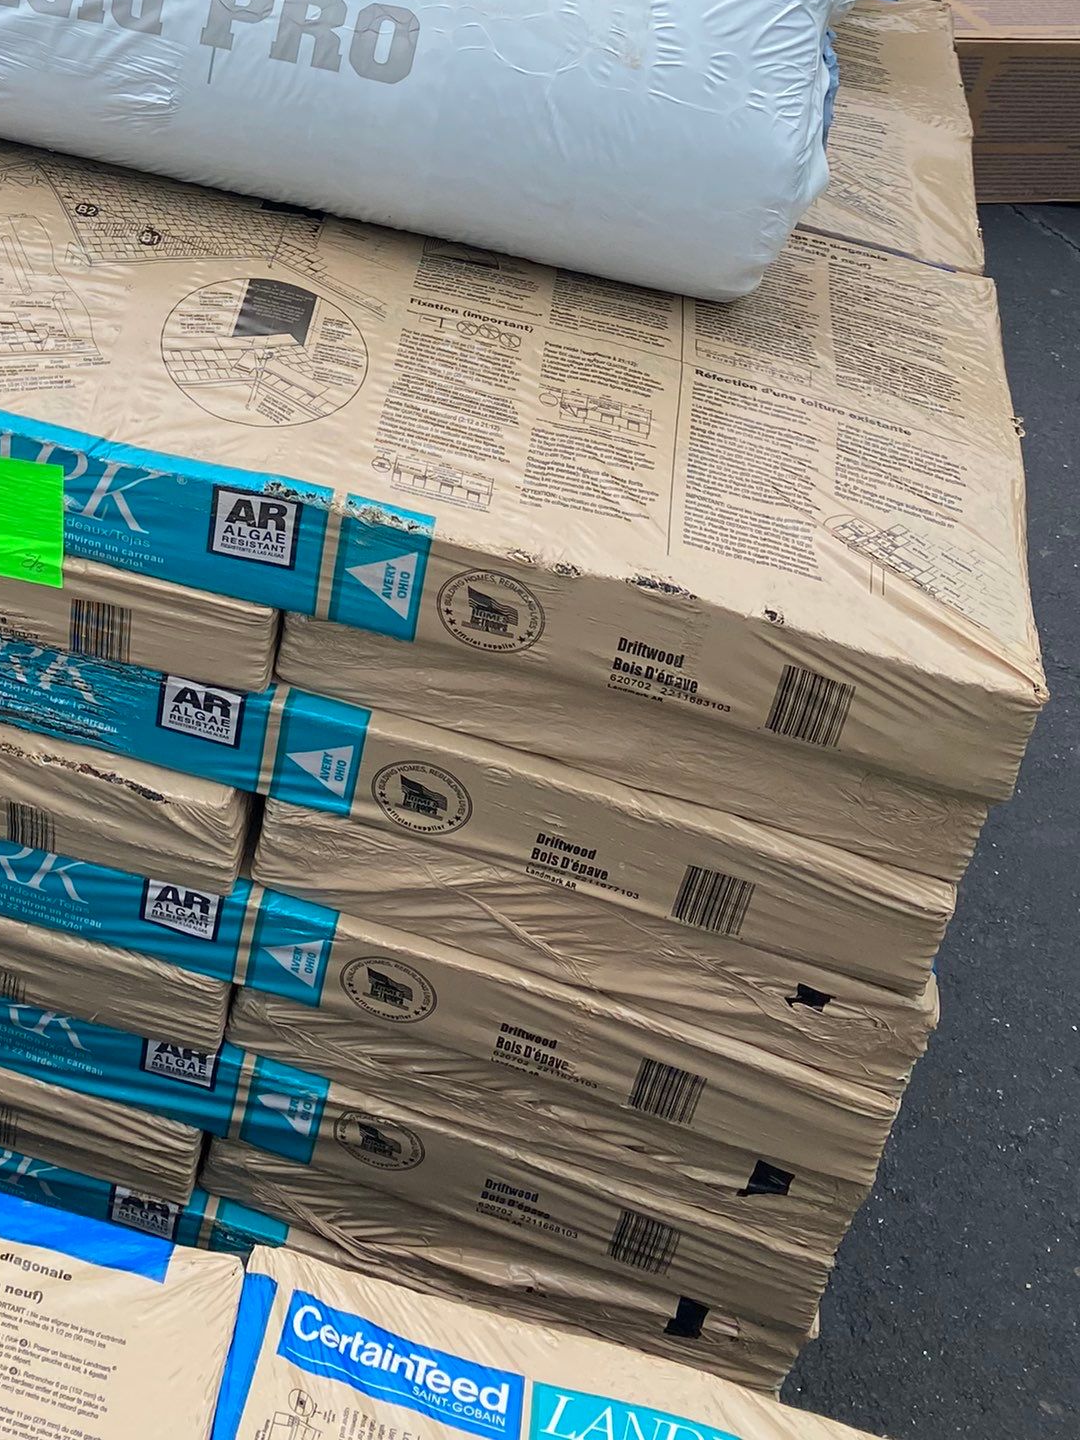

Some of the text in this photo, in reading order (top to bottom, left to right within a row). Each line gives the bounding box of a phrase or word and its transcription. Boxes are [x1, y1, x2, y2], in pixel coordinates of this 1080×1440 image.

[75, 204, 98, 216] B2
[141, 231, 162, 245] B1
[409, 297, 536, 334] Fixation (important)
[694, 368, 914, 438] Réfection d'une toiture existante
[224, 498, 288, 532] AR
[221, 534, 287, 555] RESISTANT
[222, 525, 287, 546] ALGAE
[106, 543, 165, 565] un carreau
[382, 561, 397, 601] AVERY
[397, 570, 412, 600] OHIO
[617, 636, 685, 669] Driftwood
[609, 673, 653, 692] 620702
[611, 656, 699, 695] Bois D'épave
[172, 686, 234, 718] AR
[607, 683, 664, 704] Landmark AR
[169, 713, 231, 737] RESISTANT
[170, 703, 231, 729] ALGAE
[320, 750, 334, 783] AVERY
[333, 759, 347, 783] OHIO
[535, 831, 598, 861] Driftwood
[530, 846, 609, 881] Bois D'épave
[525, 866, 578, 891] Landmark AR
[152, 900, 210, 925] ALGAE
[155, 885, 212, 917] AR
[65, 909, 104, 930] carreau
[292, 945, 303, 975] AVERY
[304, 951, 318, 975] OHIO
[499, 1021, 558, 1051] Driftwood
[152, 1051, 207, 1075] ALGAE
[495, 1035, 571, 1072] Bois D'épave
[484, 1177, 540, 1204] Driftwood
[3, 1282, 45, 1305] neuf)
[291, 1303, 510, 1416] CertainTeed
[411, 1383, 506, 1428] SAINT-GOBAIN
